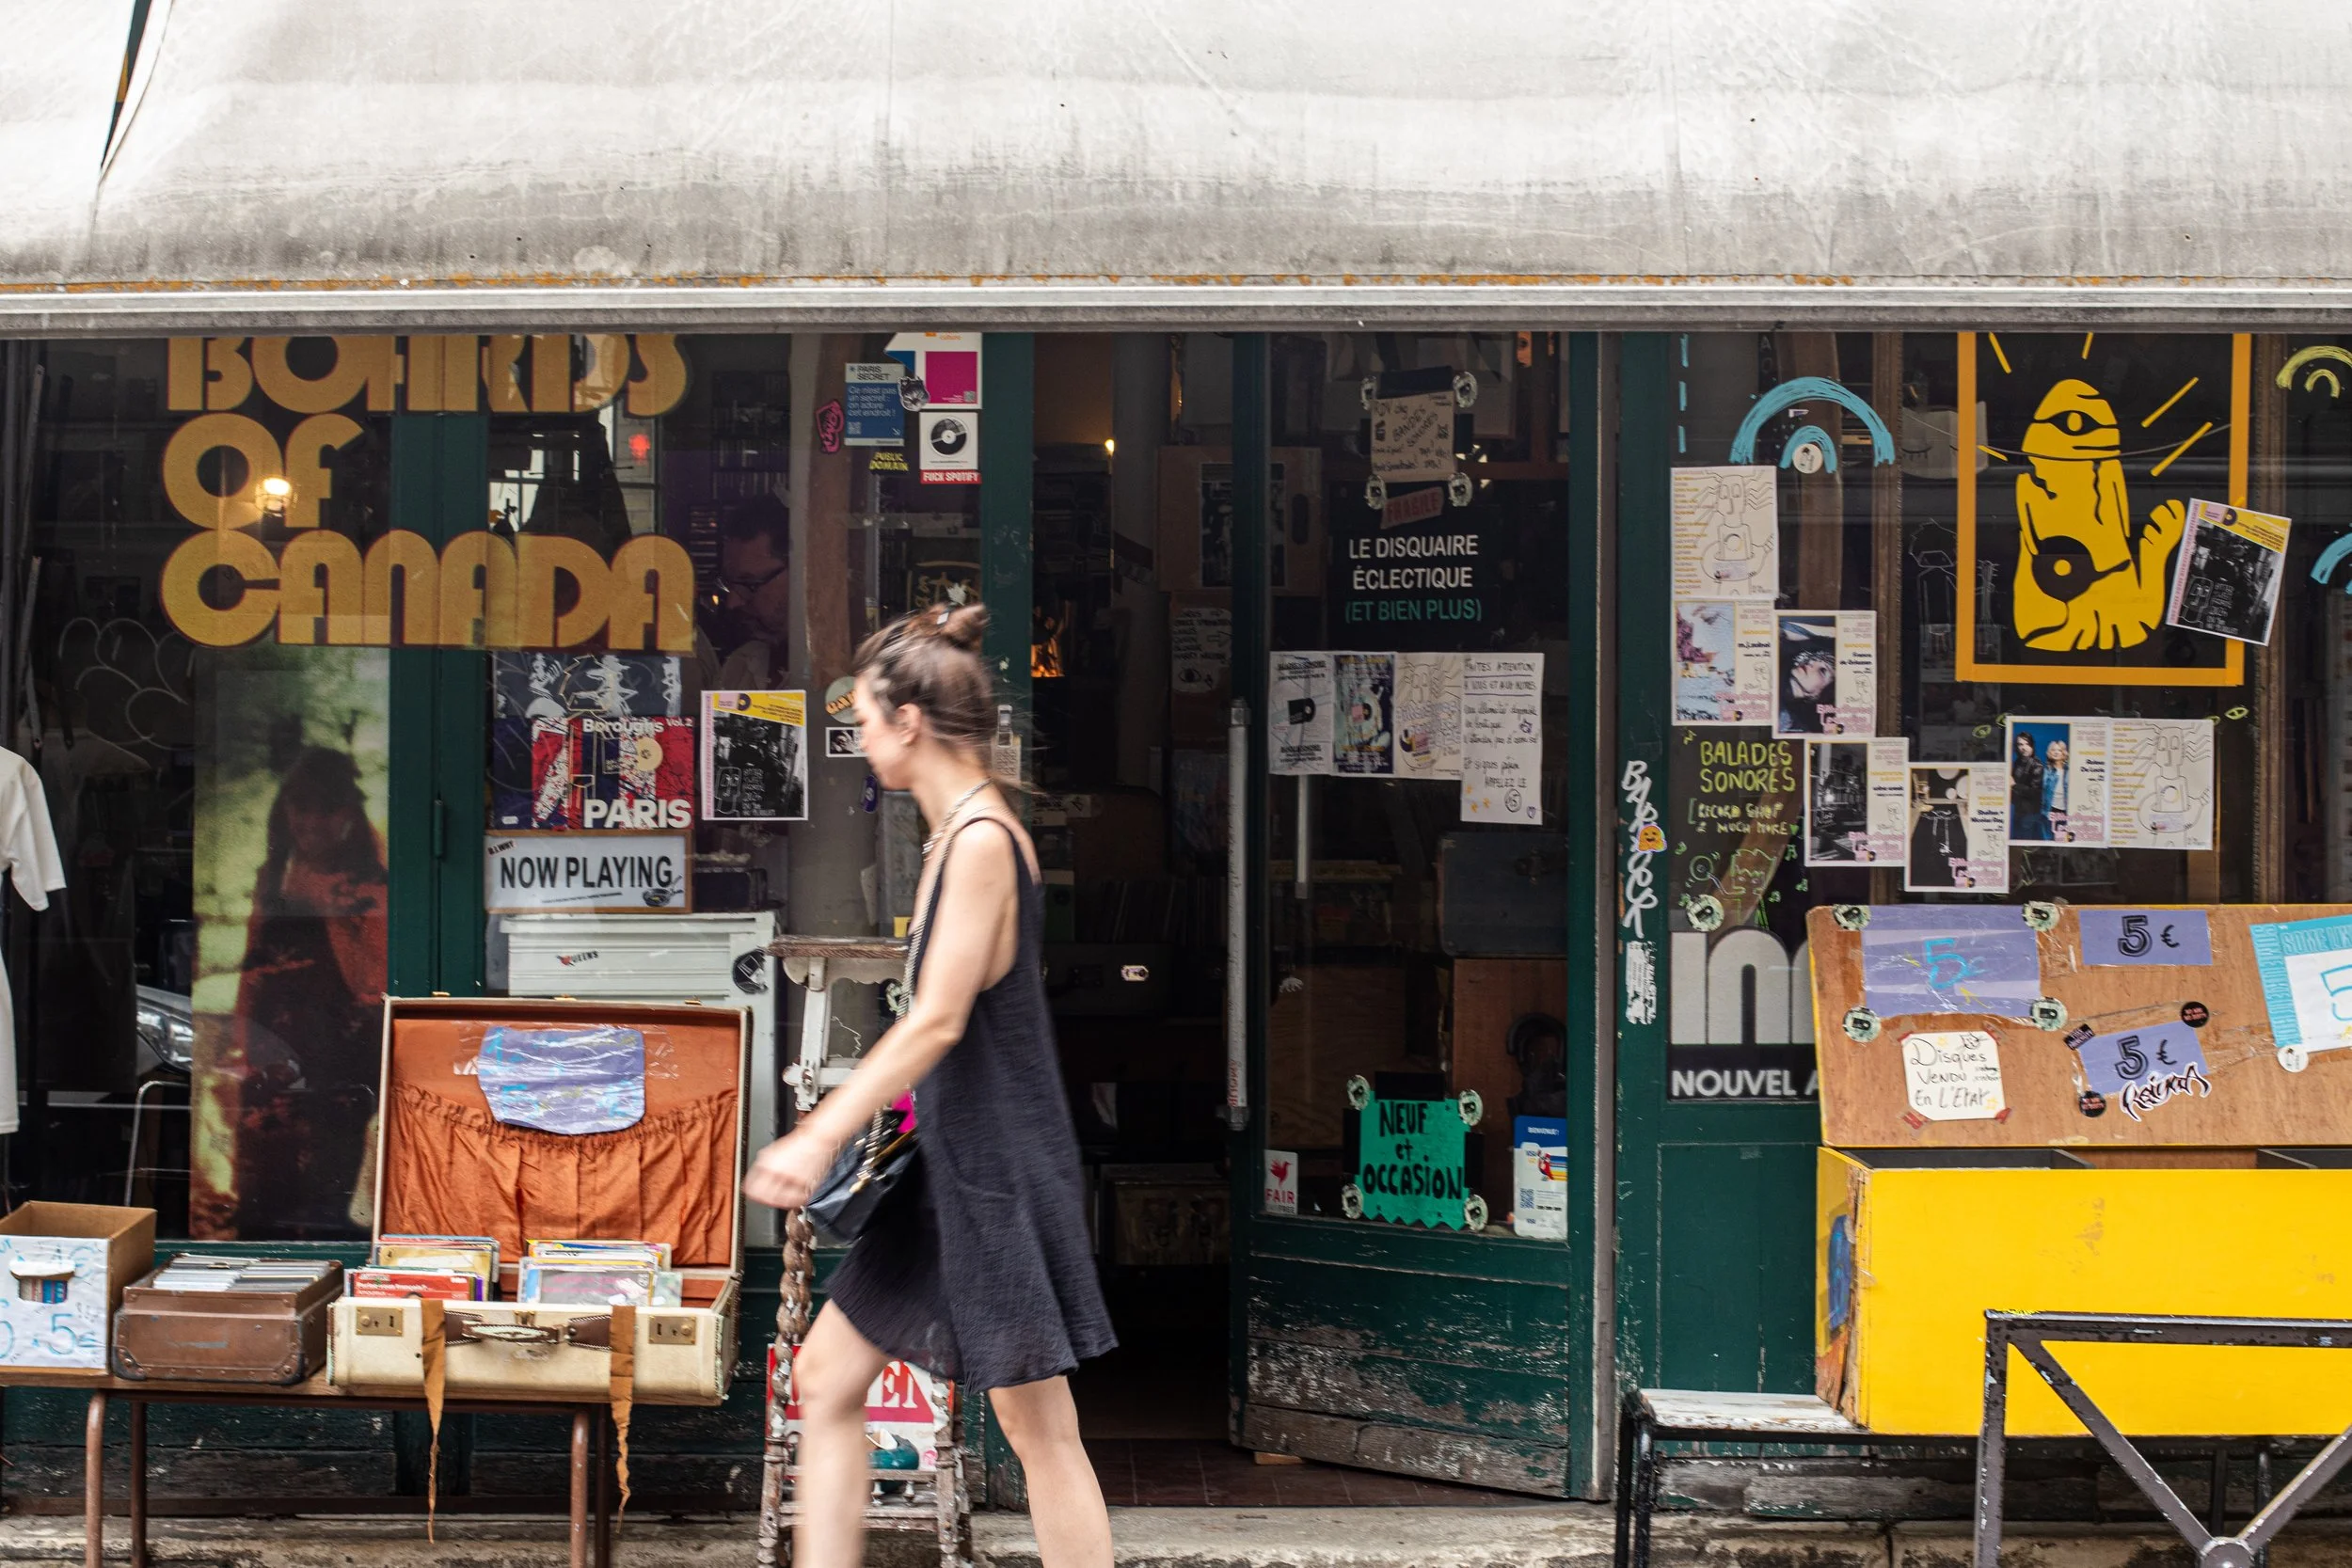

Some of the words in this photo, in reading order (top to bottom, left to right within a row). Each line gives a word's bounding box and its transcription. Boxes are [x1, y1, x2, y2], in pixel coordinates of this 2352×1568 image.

[167, 335, 690, 417] BOARDS
[946, 472, 978, 482] SPOTIFY
[1349, 538, 1372, 559] LE
[1375, 534, 1479, 558] DISQUAIRE
[160, 529, 695, 651] CANADA
[1353, 564, 1473, 590] ÉCLECTIQUE
[1378, 600, 1421, 621] BIEN
[582, 717, 664, 736] Boroughs
[1700, 740, 1793, 767] BALADES
[1700, 768, 1796, 793] SONORES
[582, 799, 692, 830] PARIS
[1697, 802, 1741, 819] RECORD
[1716, 821, 1750, 834] MUCH
[1756, 821, 1788, 835] MORE
[501, 857, 559, 888] NOW
[566, 857, 674, 888] PLAYING
[2118, 914, 2153, 958] 5
[2161, 924, 2181, 948] €
[1910, 1037, 1987, 1070] Disques
[2115, 1035, 2149, 1080] 5
[2155, 1039, 2177, 1065] €
[1672, 1069, 1796, 1097] NOUVEL
[1379, 1102, 1429, 1137] NEUF
[1396, 1141, 1413, 1162] et
[1265, 1190, 1295, 1204] FAIR
